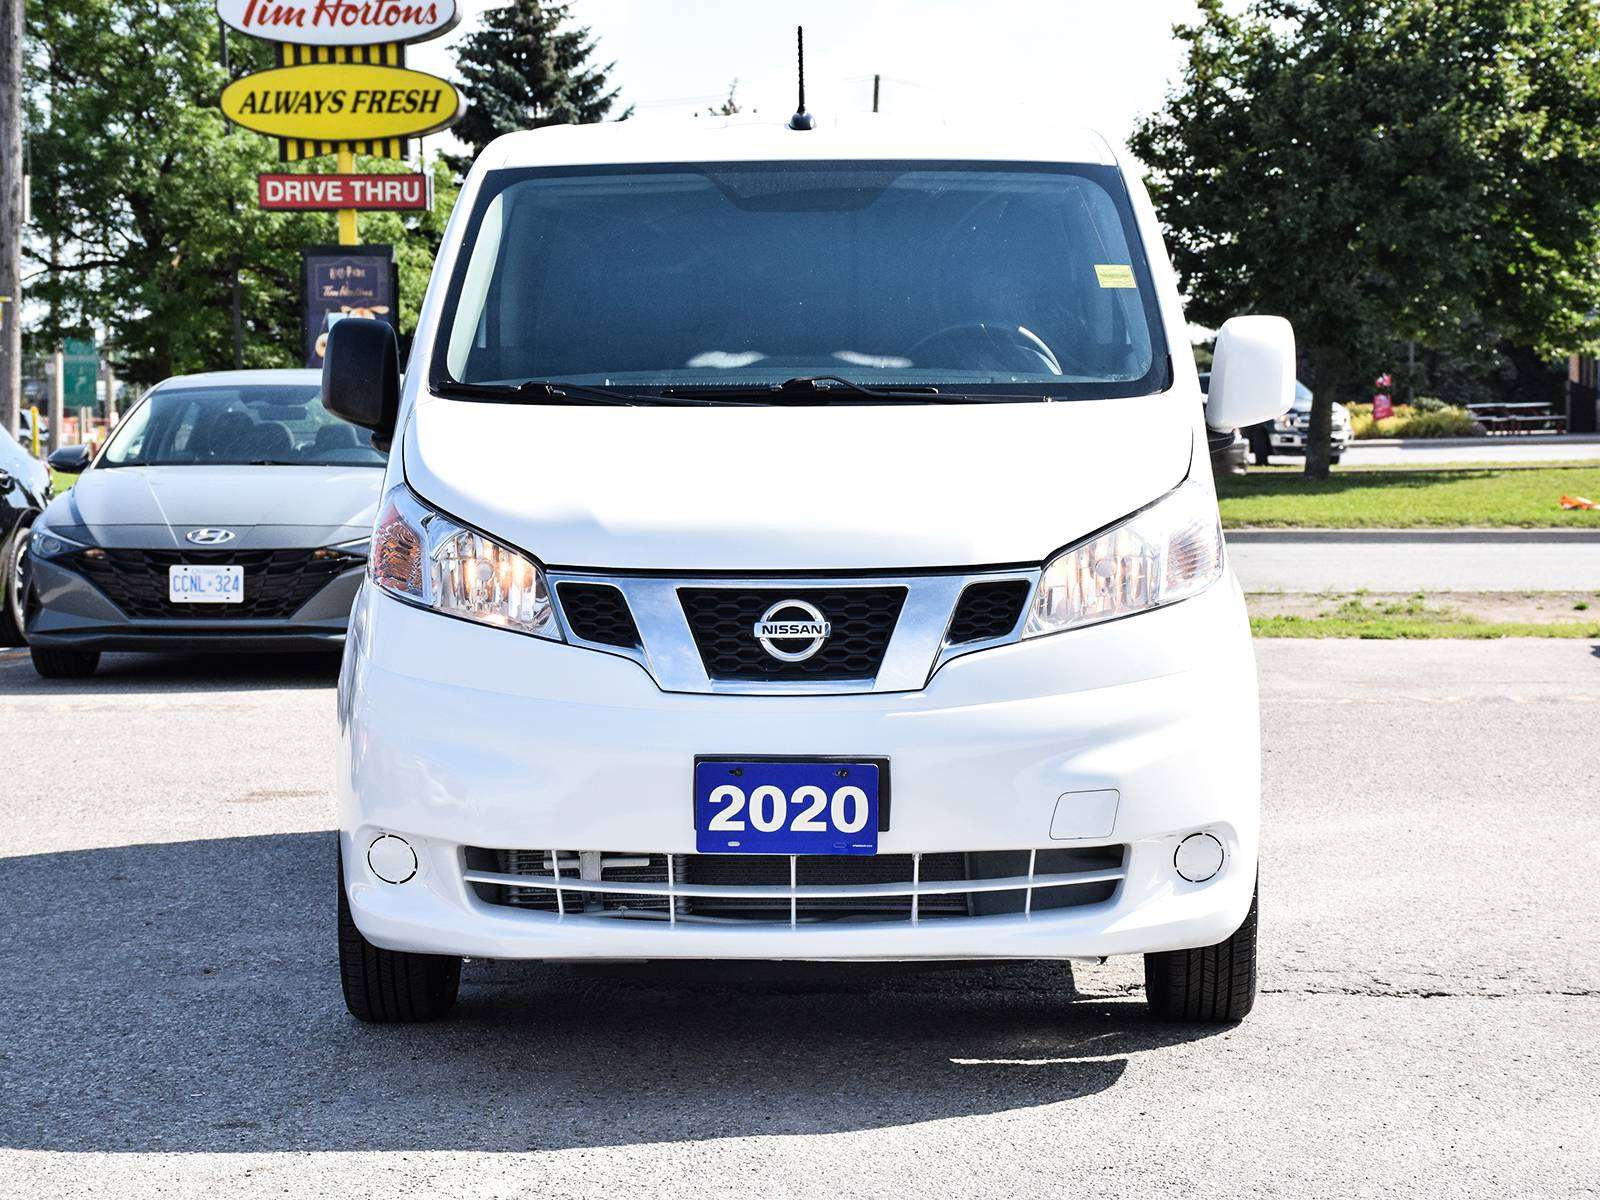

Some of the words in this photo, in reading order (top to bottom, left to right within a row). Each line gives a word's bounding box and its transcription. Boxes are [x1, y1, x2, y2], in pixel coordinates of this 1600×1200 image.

[242, 0, 304, 28] Tim
[312, 0, 438, 28] Hortons
[238, 89, 346, 115] ALWAYS
[350, 89, 442, 114] FRESH
[266, 180, 343, 202] DRIVE
[350, 180, 420, 202] THRU
[762, 625, 822, 634] NISSAN
[708, 785, 869, 833] 2020
